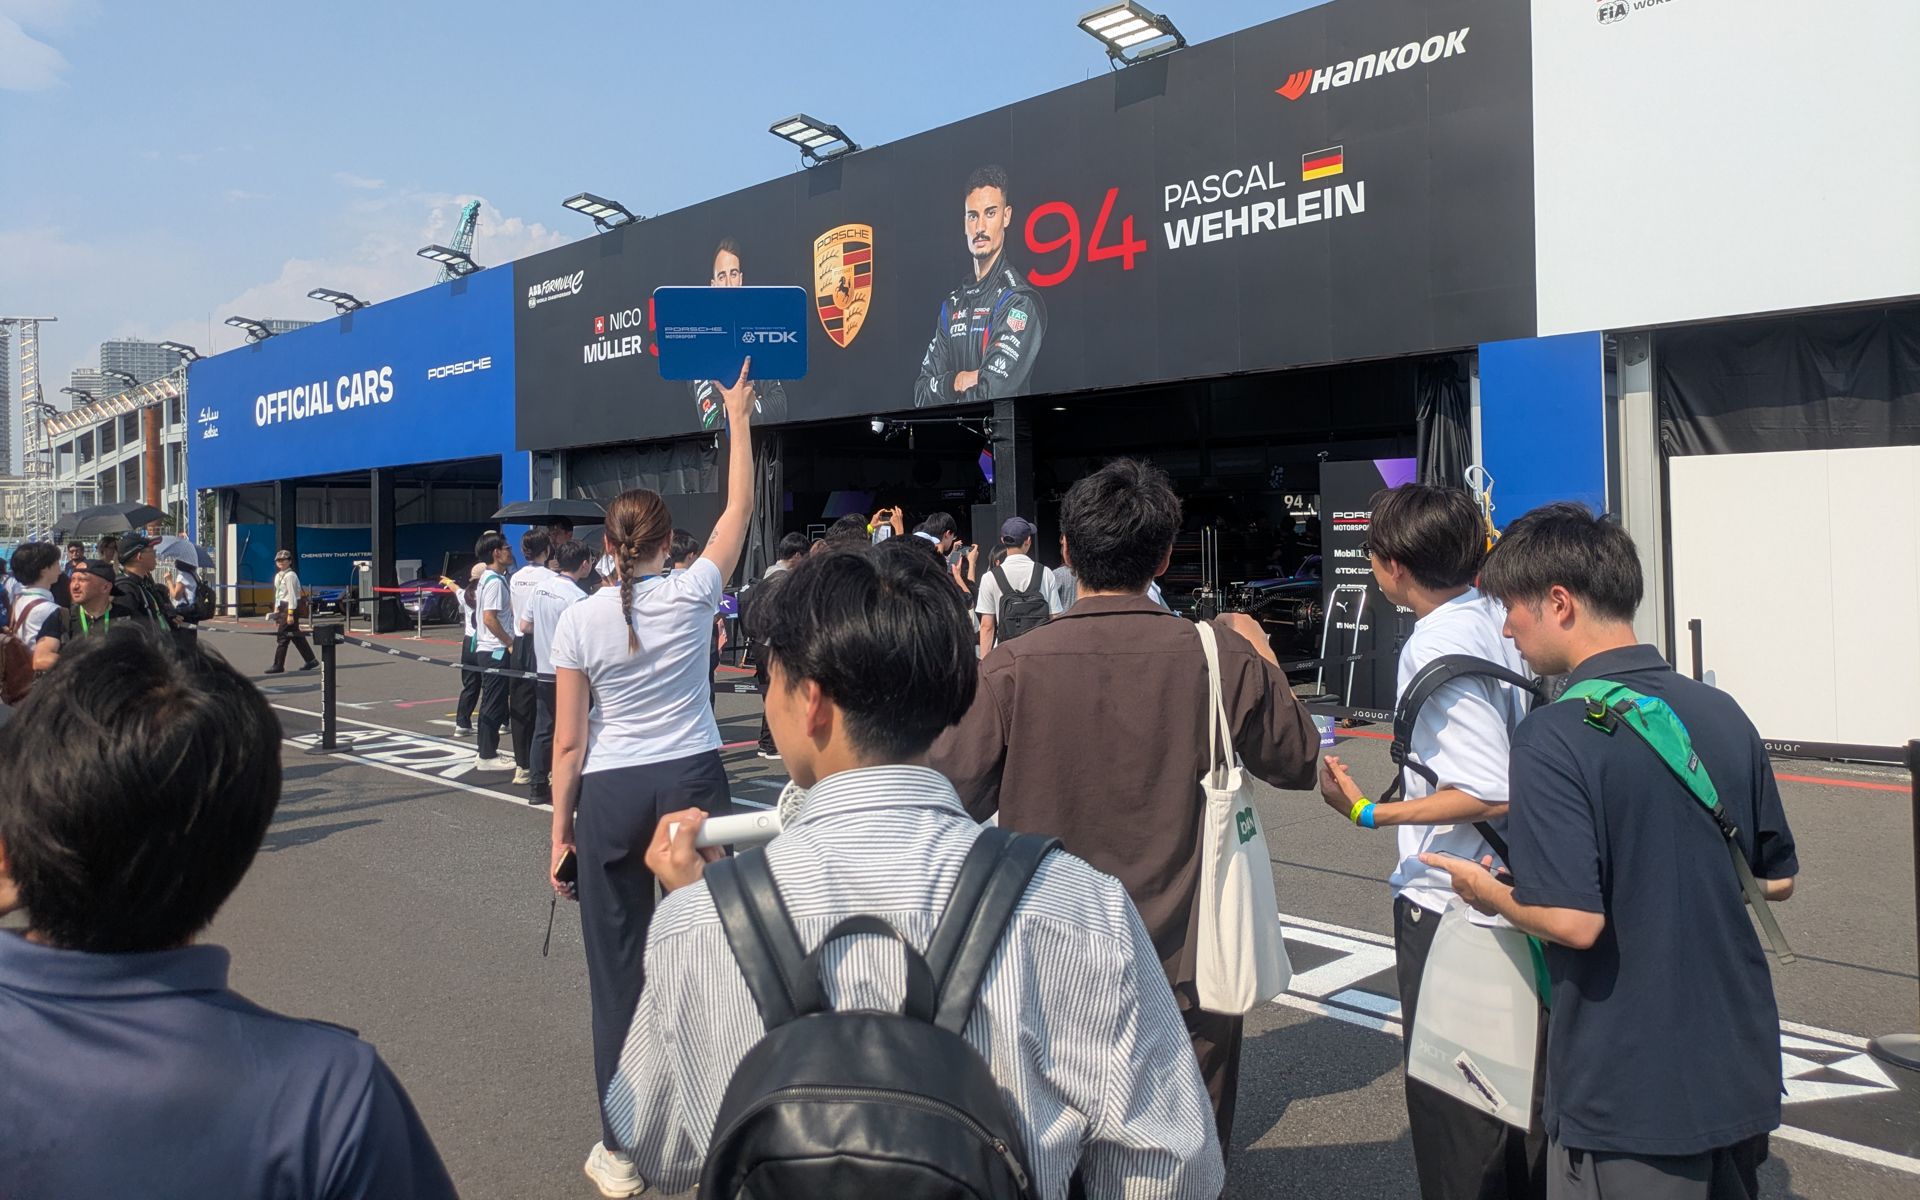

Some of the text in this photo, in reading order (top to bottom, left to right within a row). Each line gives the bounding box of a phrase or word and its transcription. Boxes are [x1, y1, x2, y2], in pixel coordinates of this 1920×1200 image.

[1164, 161, 1286, 212] PASCAL
[1163, 181, 1365, 250] WEHRLEIN
[817, 229, 869, 251] PORSCHE
[1024, 187, 1147, 287] 94
[528, 284, 541, 298] ABB
[610, 308, 642, 331] NICO
[754, 331, 798, 343] TDK
[583, 335, 642, 364] MÜLLER
[427, 356, 492, 380] PORSCHE
[255, 365, 394, 427] OFFICIAL CARS
[1284, 494, 1304, 509] 94
